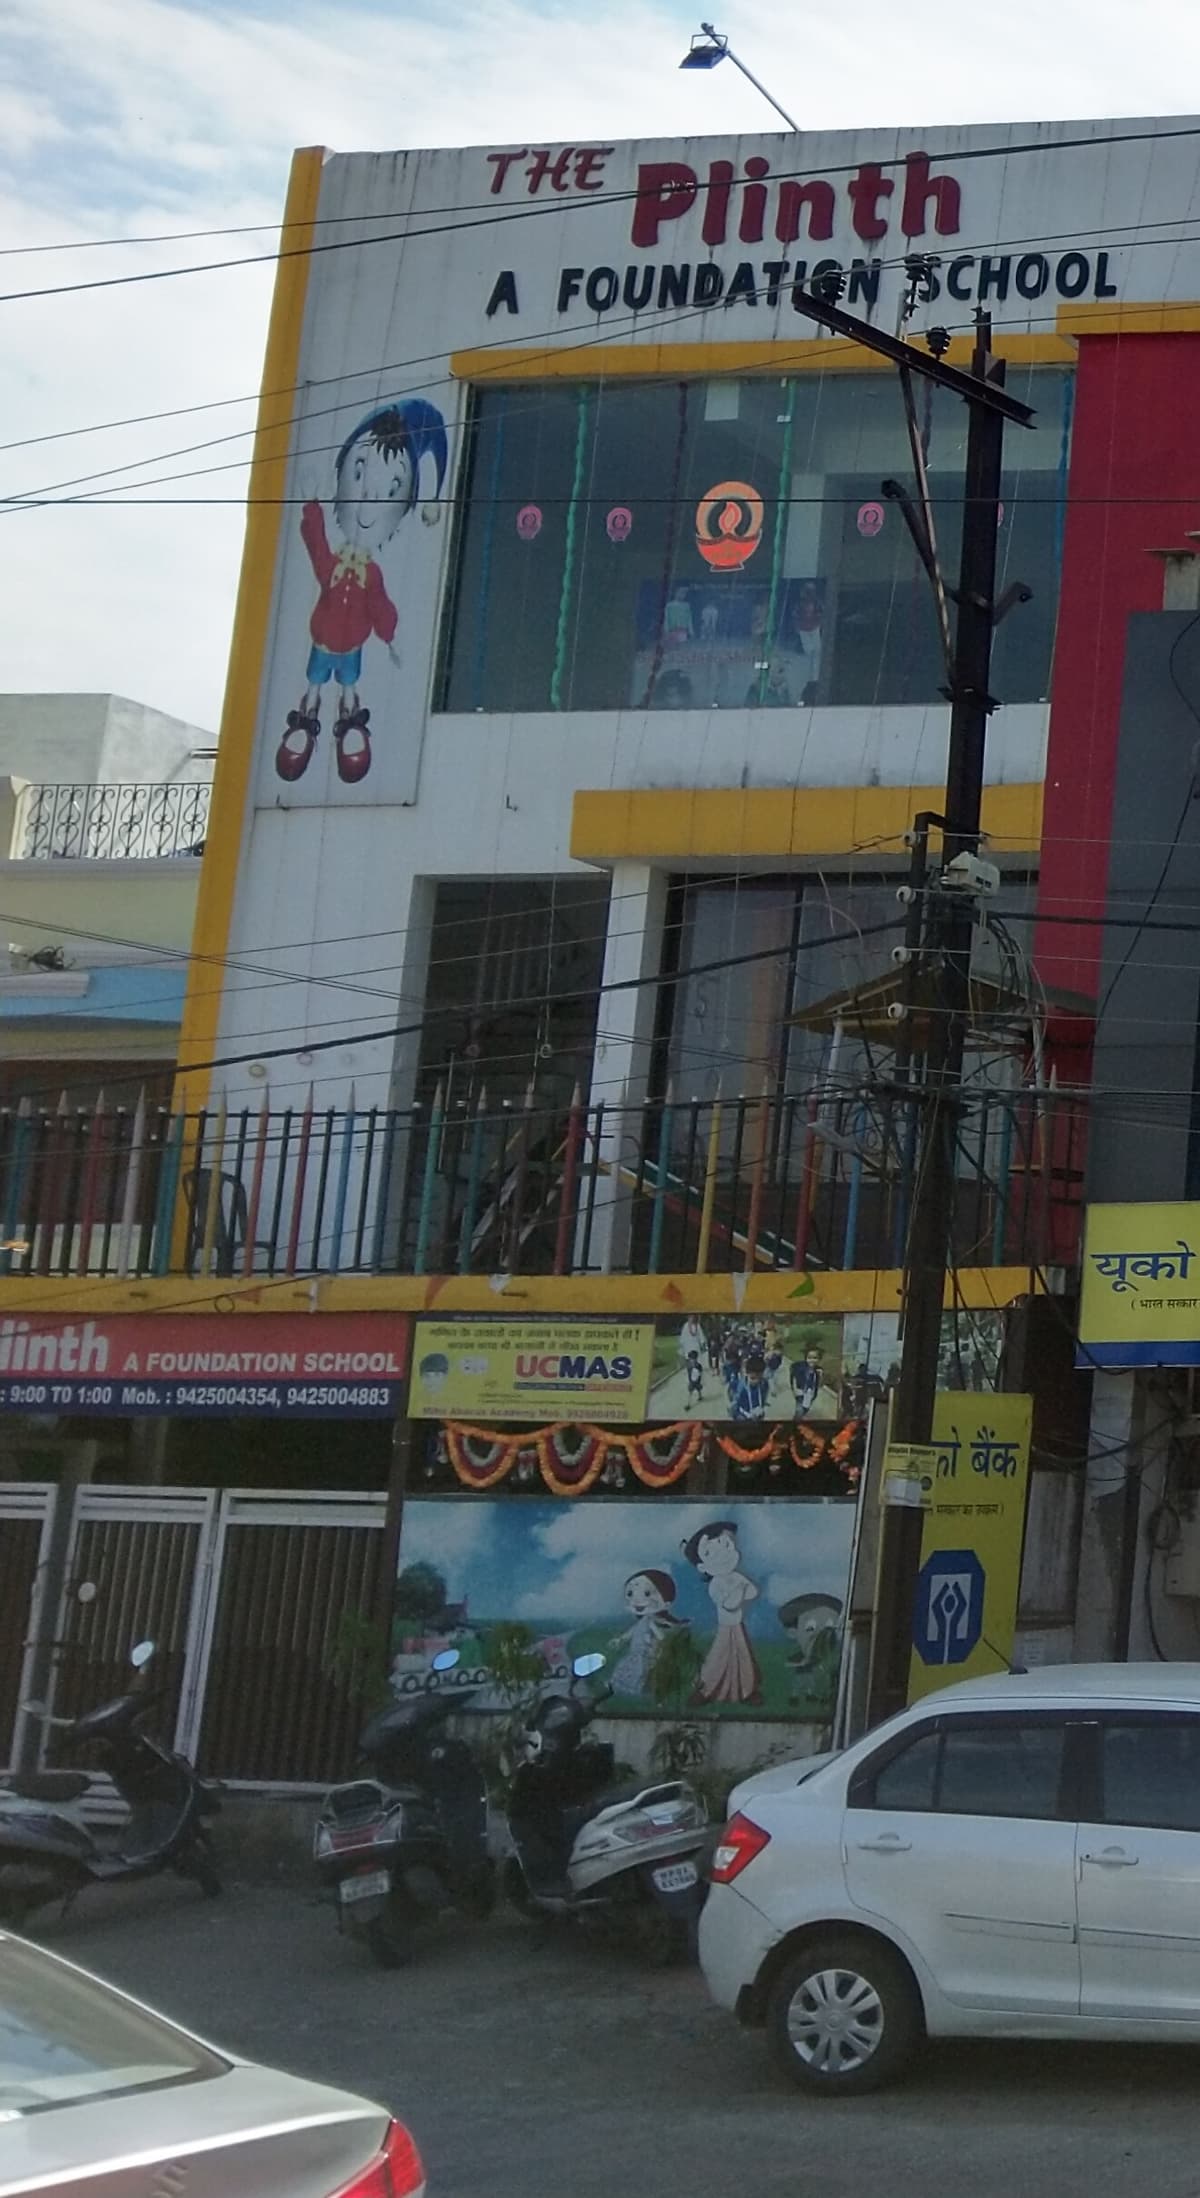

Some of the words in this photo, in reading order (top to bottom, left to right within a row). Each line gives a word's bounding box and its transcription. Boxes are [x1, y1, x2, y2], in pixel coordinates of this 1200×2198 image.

[486, 147, 615, 195] THE
[631, 151, 961, 248] Plinth
[485, 270, 518, 316] A
[556, 258, 881, 313] FOUNDATION
[918, 252, 1117, 303] SCHOOL
[1090, 1240, 1197, 1292] यूको
[123, 1353, 139, 1373] A
[147, 1352, 296, 1373] FOUNDATION
[303, 1353, 400, 1373] SCHOOL
[516, 1354, 632, 1380] UCMAS
[10, 1385, 46, 1404] 9:00
[78, 1386, 112, 1405] 1:00
[175, 1387, 281, 1408] 9425004354,
[286, 1388, 390, 1406] 9425004883
[970, 1425, 1020, 1478] बैंक
